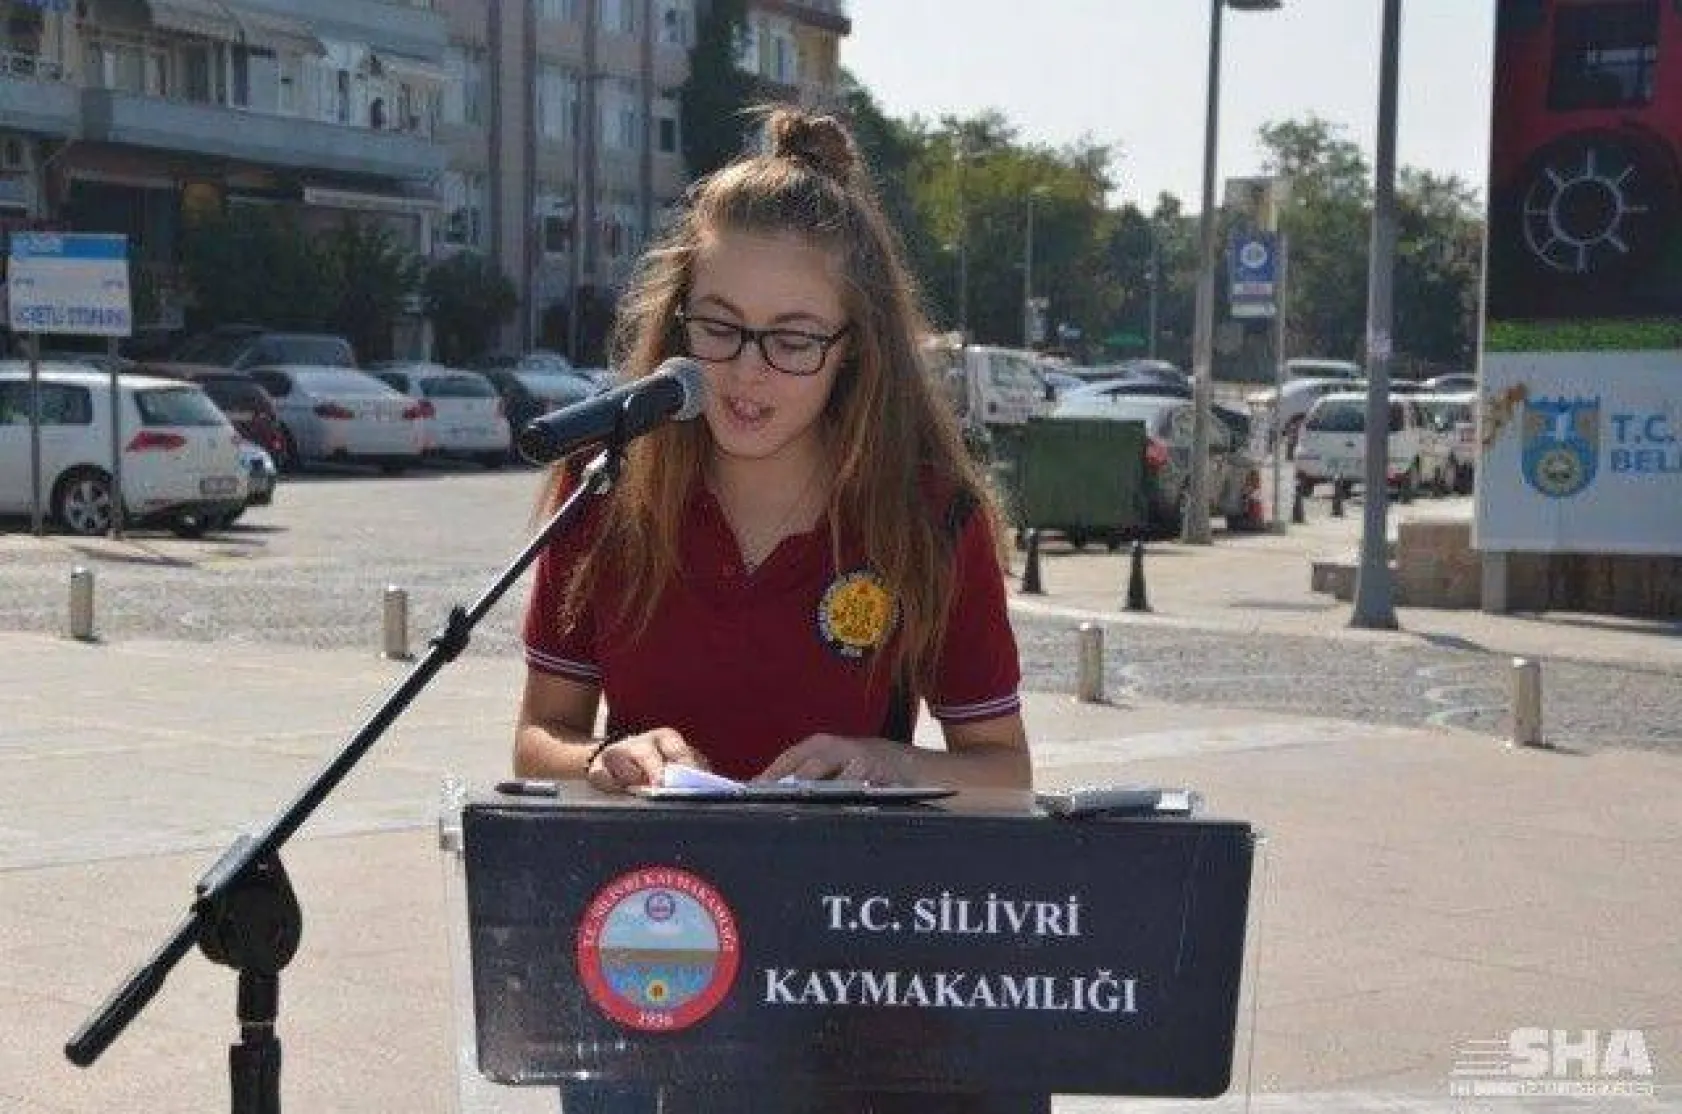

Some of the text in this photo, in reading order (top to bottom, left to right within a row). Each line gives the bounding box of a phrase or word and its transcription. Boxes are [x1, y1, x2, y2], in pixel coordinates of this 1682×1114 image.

[1610, 414, 1675, 445] T.C.
[822, 890, 1081, 936] T.C. SİLİVRİ
[763, 967, 1139, 1013] KAYMAKAMLIĞI
